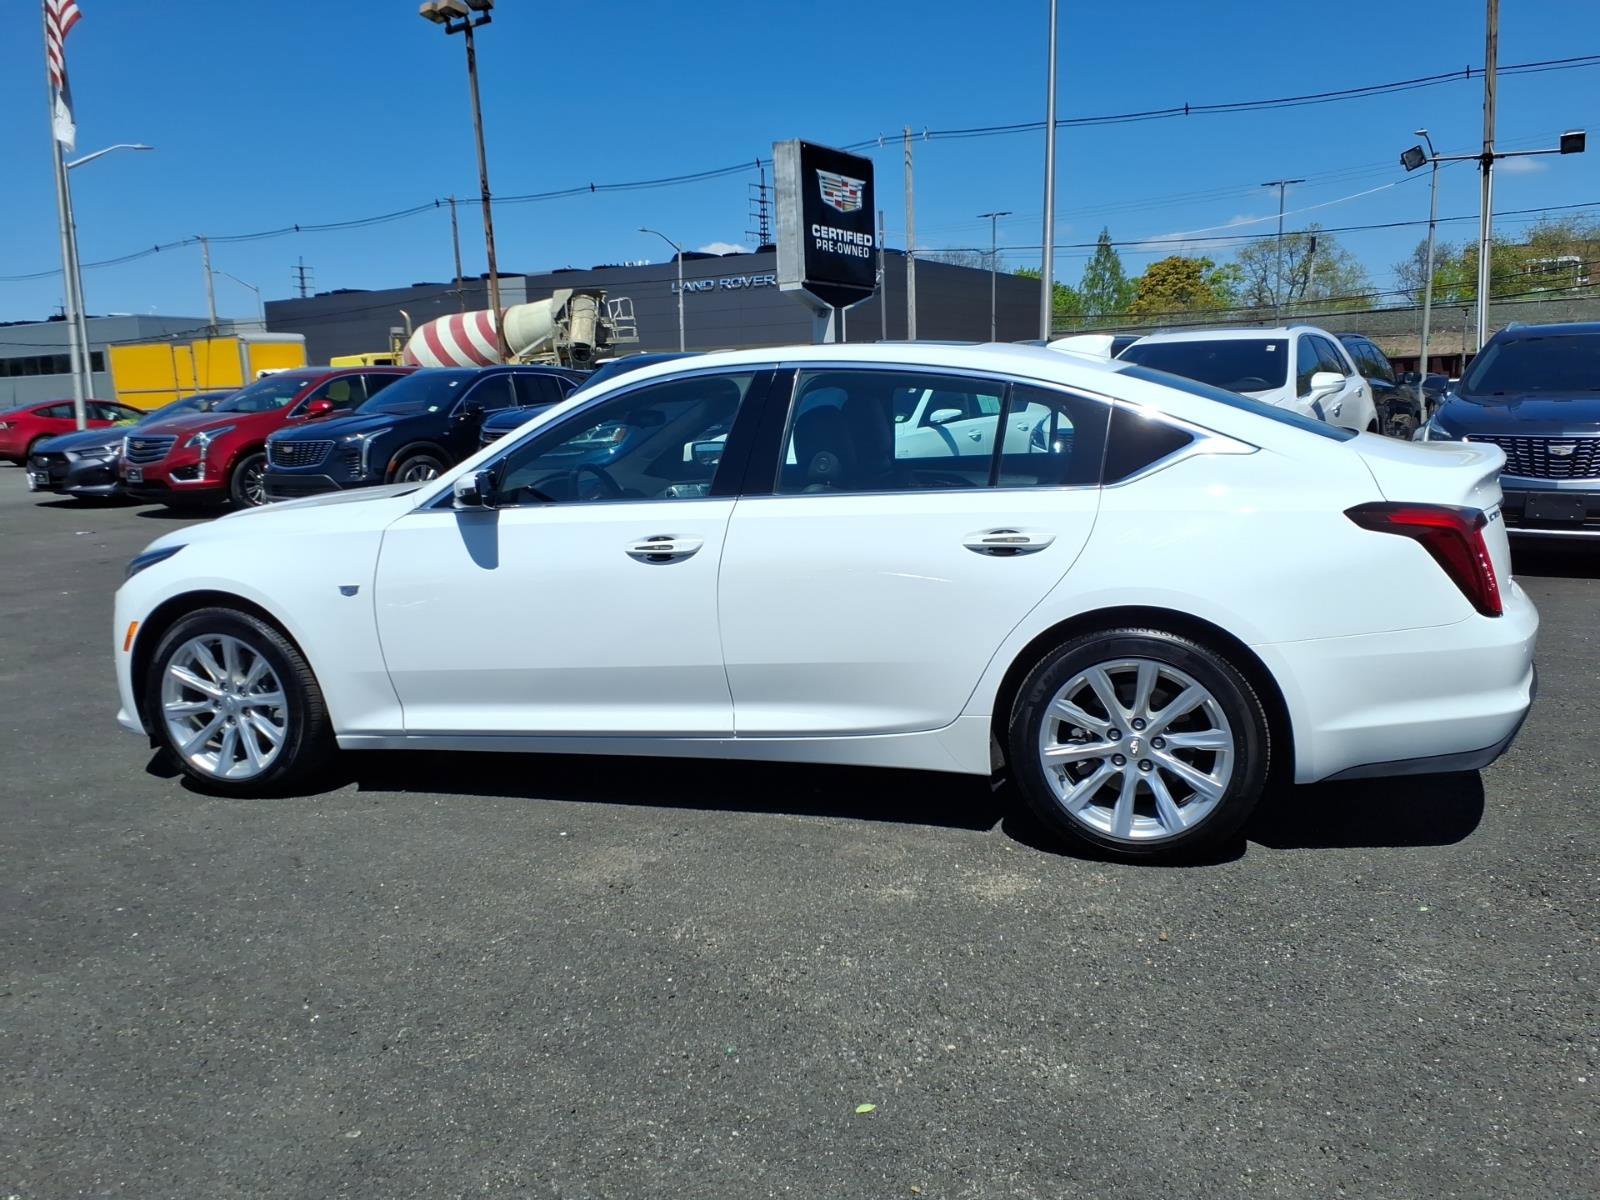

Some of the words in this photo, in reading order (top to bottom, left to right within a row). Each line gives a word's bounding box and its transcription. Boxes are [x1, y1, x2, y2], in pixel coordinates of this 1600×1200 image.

[812, 224, 872, 246] CERTIFIED
[816, 238, 869, 258] PRE-OWNED
[671, 280, 715, 293] LAND
[719, 274, 776, 289] ROVER
